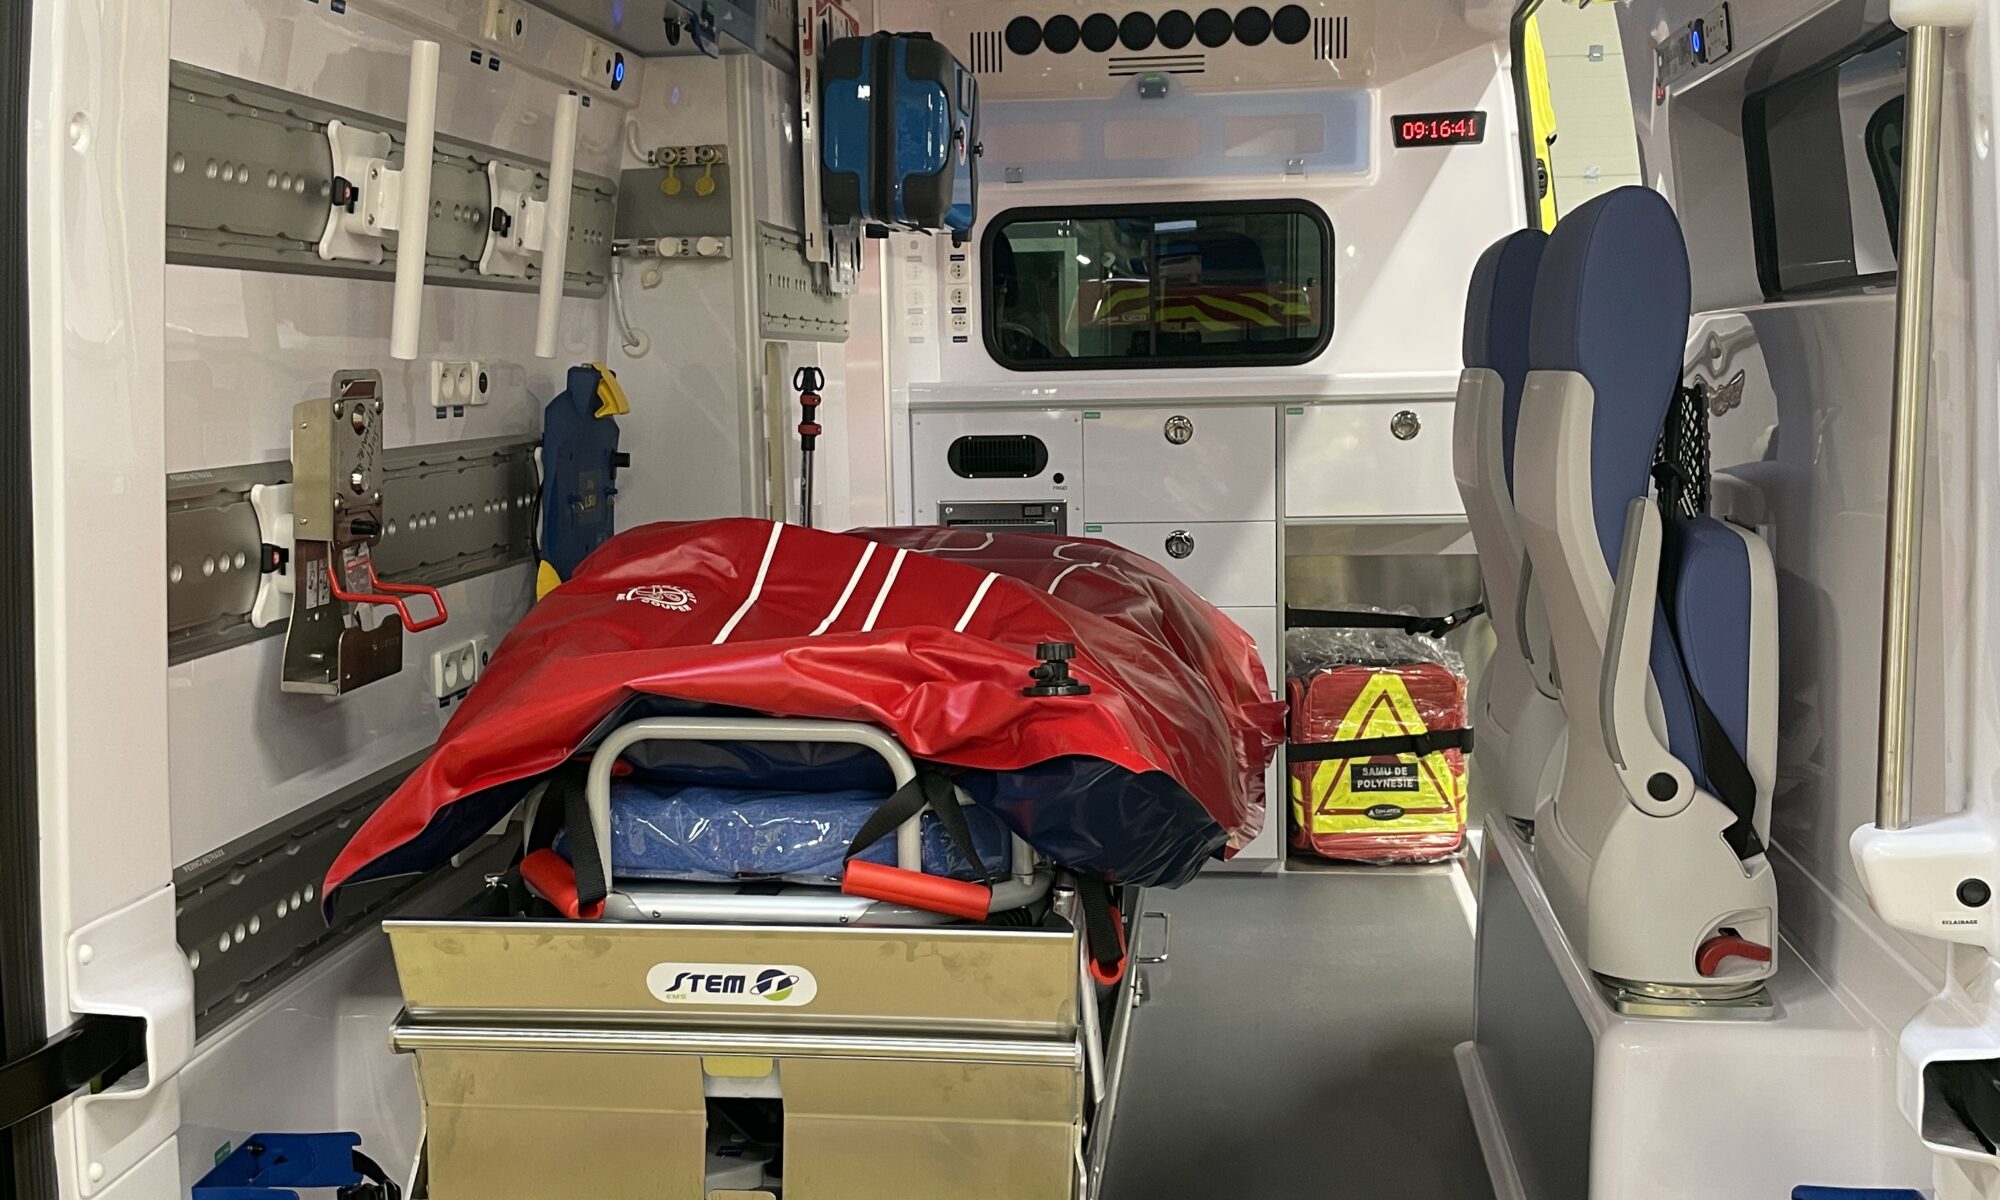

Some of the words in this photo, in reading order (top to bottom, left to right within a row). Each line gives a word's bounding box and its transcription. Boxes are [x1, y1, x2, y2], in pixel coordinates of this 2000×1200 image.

[1402, 119, 1476, 140] 09:16:41
[1362, 767, 1392, 776] SAMU
[1394, 767, 1408, 776] DE
[1357, 779, 1414, 788] POLYNESIE
[664, 972, 747, 994] STEM
